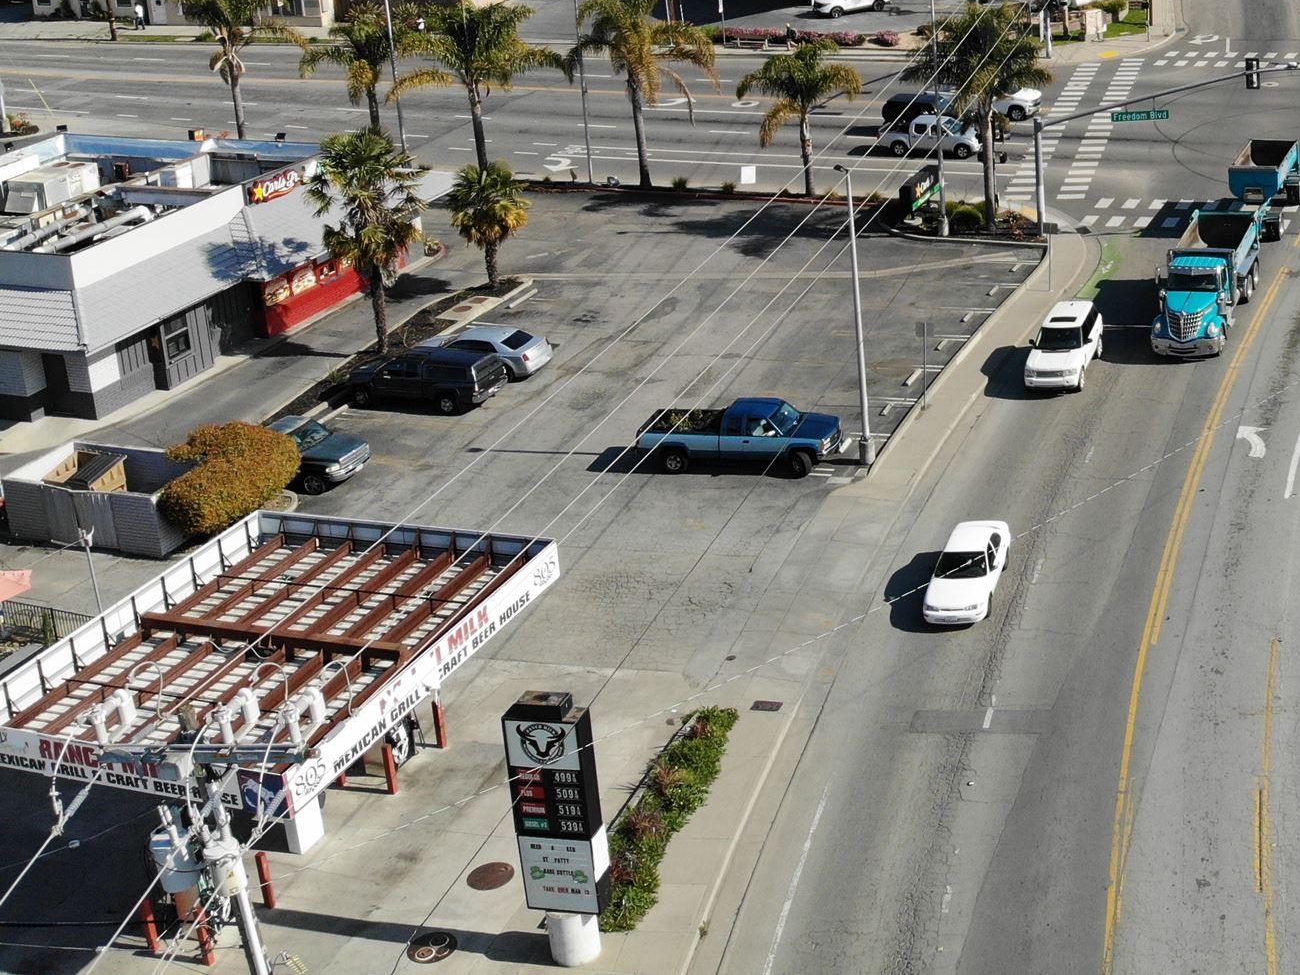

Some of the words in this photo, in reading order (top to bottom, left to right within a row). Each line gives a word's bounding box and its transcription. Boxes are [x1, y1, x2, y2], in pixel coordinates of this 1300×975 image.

[1113, 112, 1148, 121] Freedom
[1149, 110, 1167, 120] Blvd
[533, 555, 556, 587] 805
[447, 604, 490, 656] MILK
[333, 717, 388, 774] MEXICAN
[390, 689, 421, 722] GRILL
[471, 621, 496, 651] BEER
[499, 590, 531, 626] HOUSE
[39, 739, 114, 771] RANC
[0, 753, 46, 771] EXICAN
[153, 781, 187, 797] BEER
[294, 758, 326, 796] 805
[554, 772, 572, 783] 499
[556, 788, 574, 799] 509
[558, 805, 576, 816] 519
